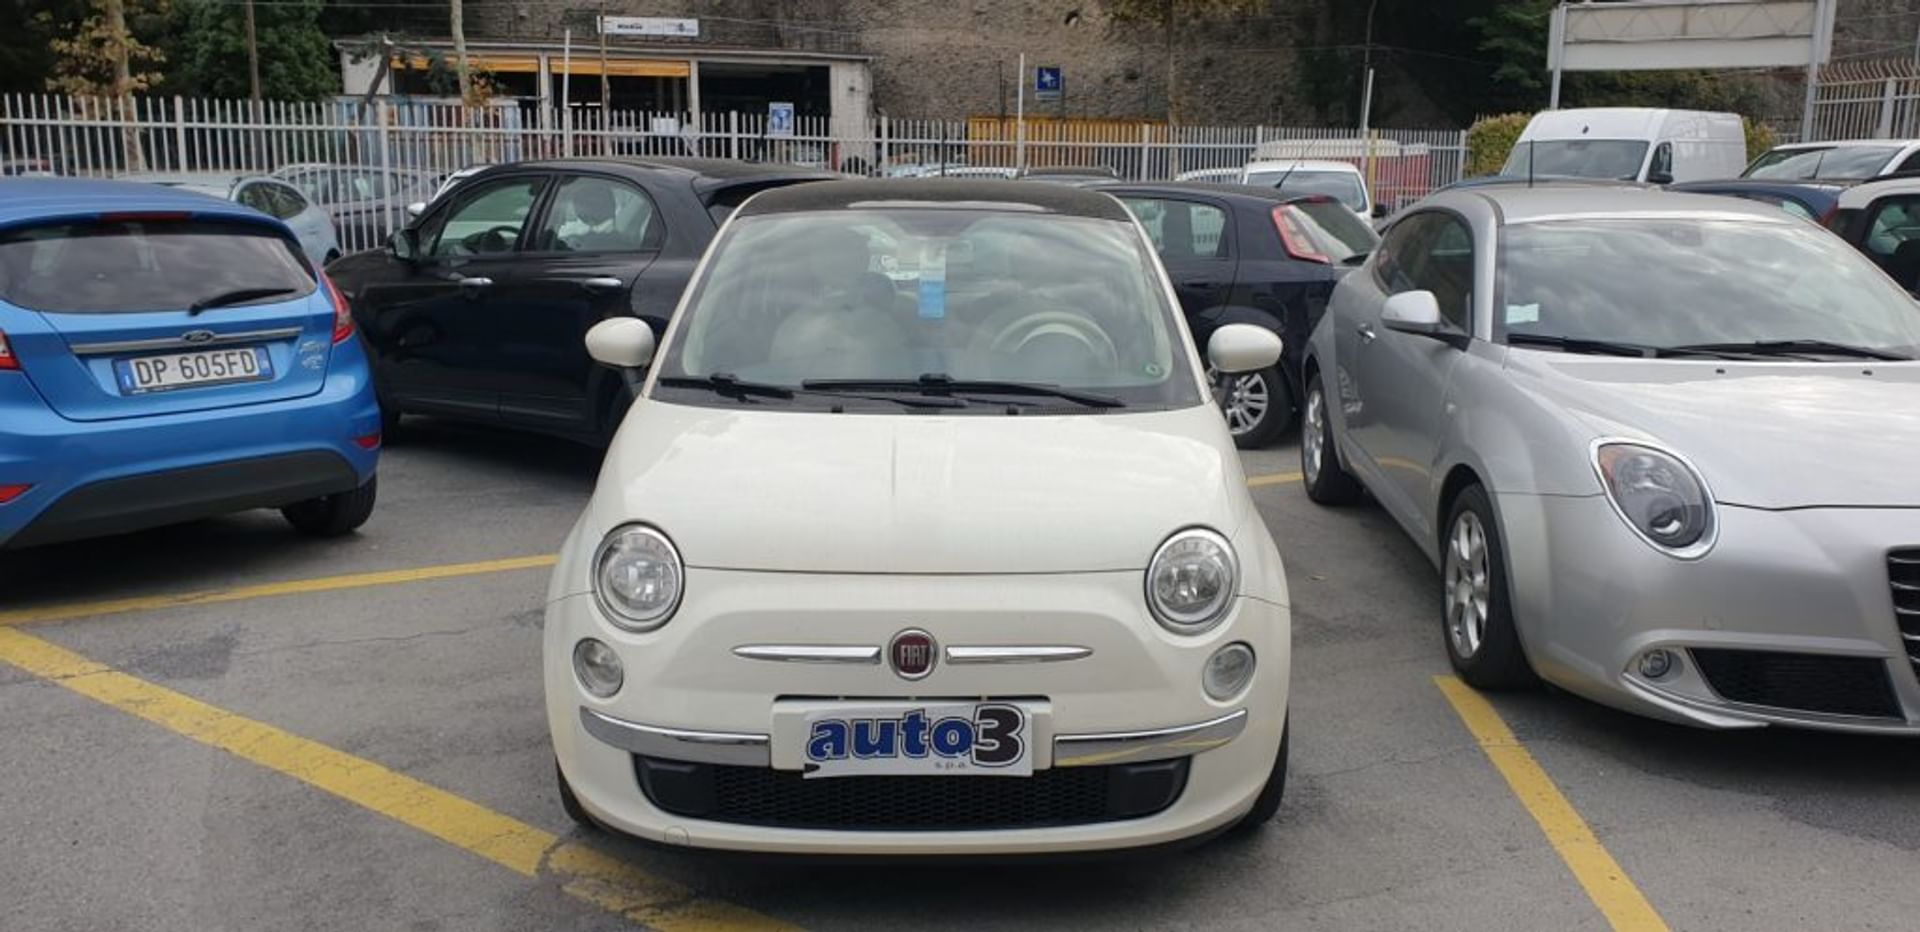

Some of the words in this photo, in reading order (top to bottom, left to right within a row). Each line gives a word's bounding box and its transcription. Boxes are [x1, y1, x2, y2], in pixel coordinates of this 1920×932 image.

[134, 358, 168, 385] DP
[179, 351, 256, 380] 605FD
[900, 644, 928, 667] FIAT
